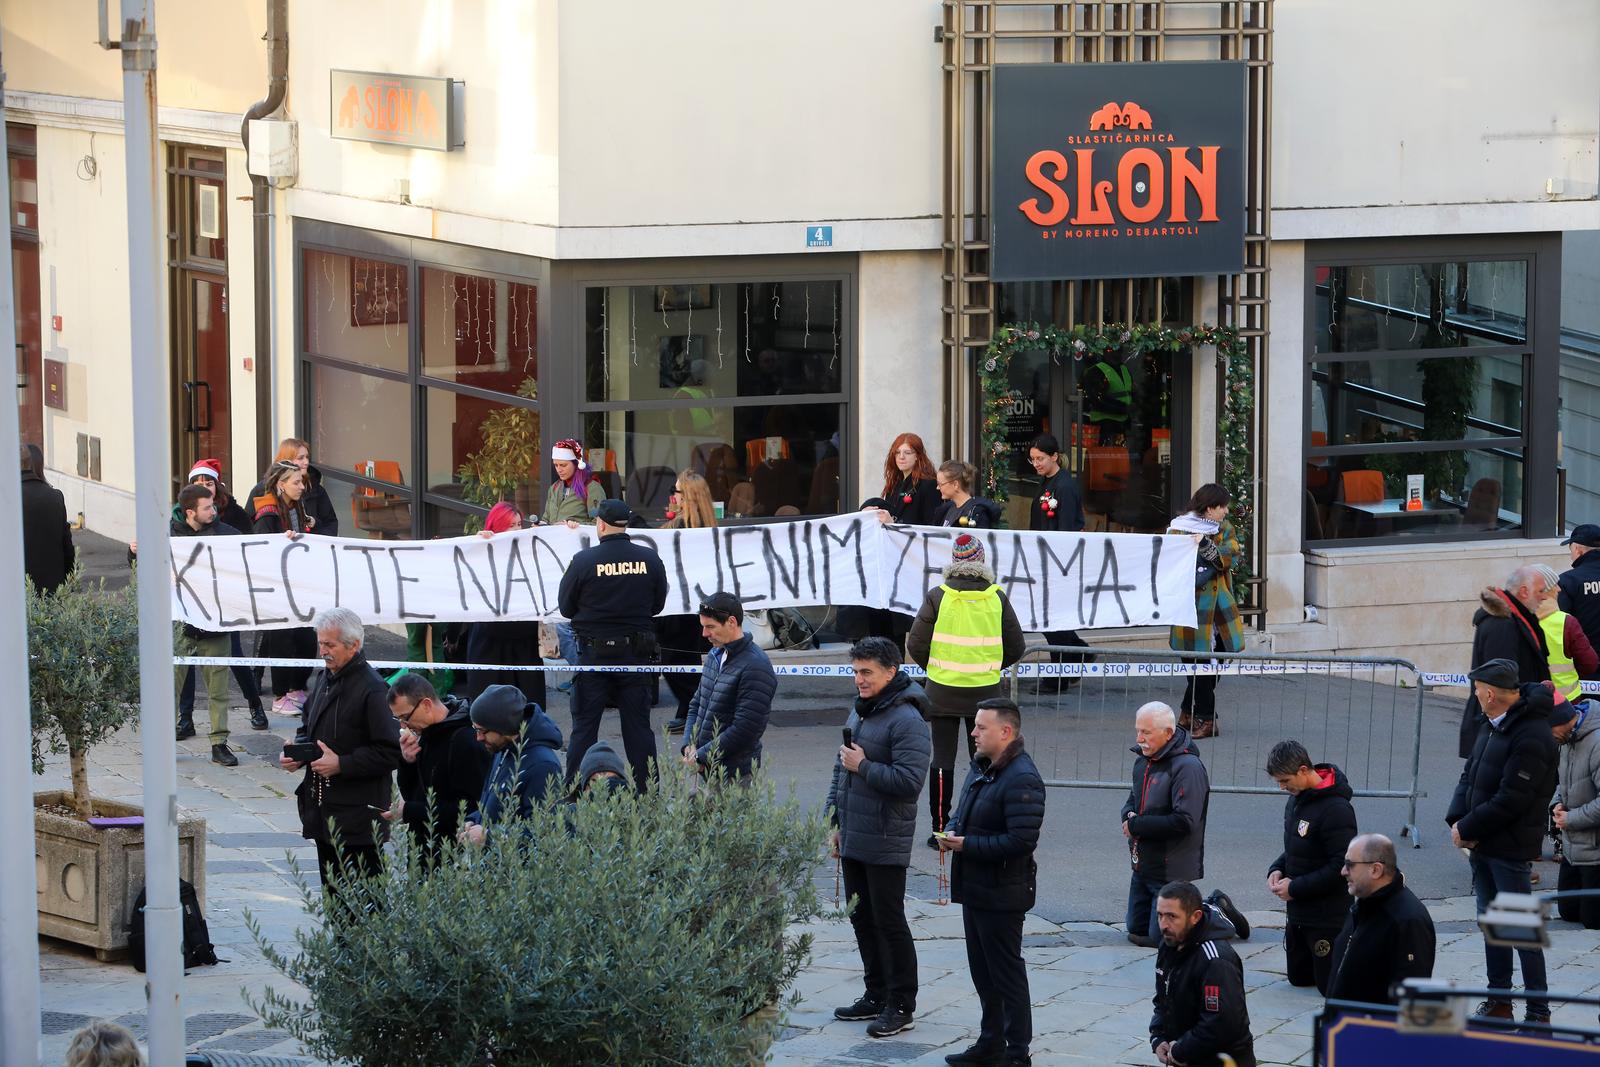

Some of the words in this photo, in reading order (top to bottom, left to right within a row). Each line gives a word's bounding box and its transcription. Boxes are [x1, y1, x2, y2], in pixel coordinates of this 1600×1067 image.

[364, 84, 413, 135] SLON
[1068, 133, 1175, 145] SLASTIČARNICA
[1018, 146, 1221, 226] SLON
[815, 227, 823, 240] 4
[1042, 230, 1058, 239] BY
[1065, 228, 1119, 239] MORENO
[1126, 226, 1199, 237] DEBARTOLI
[596, 561, 648, 577] POLICIJA
[802, 666, 831, 675] STOP
[1102, 664, 1131, 674] STOP
